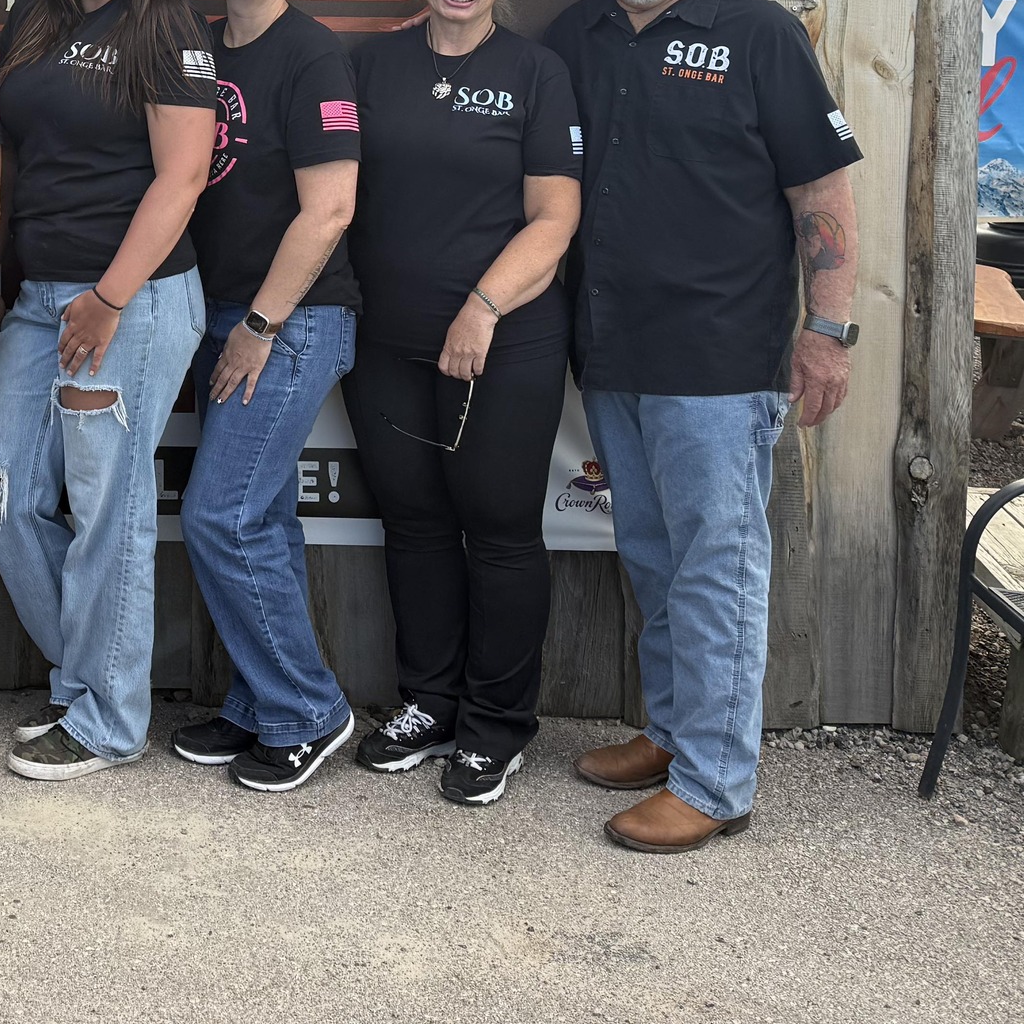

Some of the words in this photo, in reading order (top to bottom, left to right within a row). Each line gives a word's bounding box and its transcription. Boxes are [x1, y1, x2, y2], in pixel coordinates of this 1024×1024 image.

[69, 59, 94, 70] ONGE
[95, 64, 114, 75] BAR
[661, 66, 675, 77] ST.
[678, 68, 704, 81] ONGE
[704, 71, 725, 84] BAR
[227, 94, 242, 121] BAR
[454, 87, 515, 111] SOB
[555, 492, 593, 512] Crown
